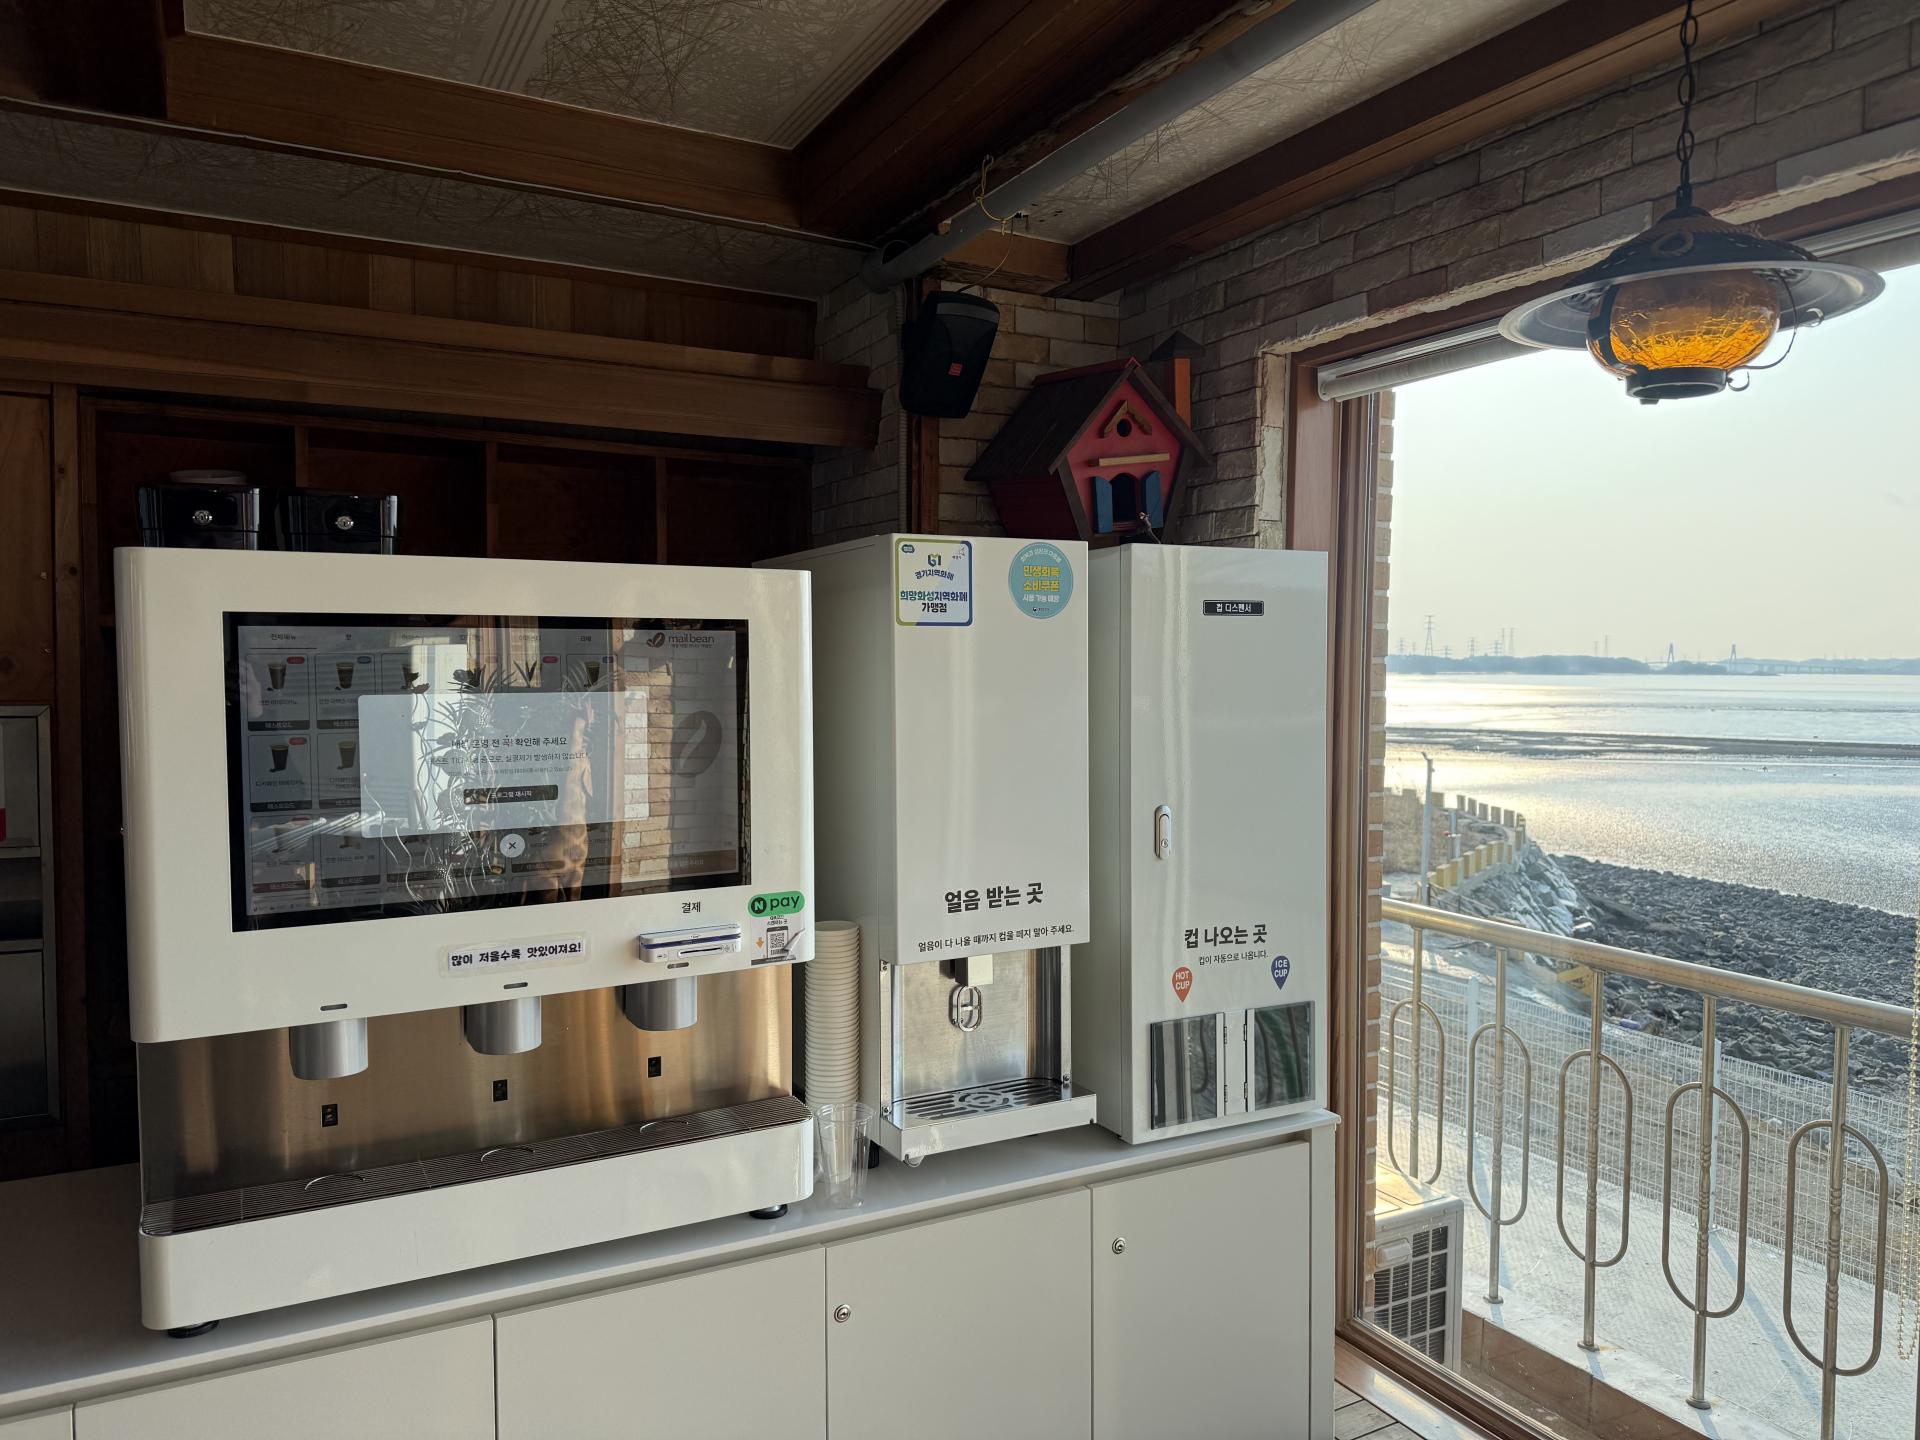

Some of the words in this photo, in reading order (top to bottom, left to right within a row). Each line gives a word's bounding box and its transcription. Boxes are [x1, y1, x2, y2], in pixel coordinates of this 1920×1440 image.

[1023, 565, 1061, 577] 민생회복
[1023, 580, 1060, 592] 소비쿠폰
[900, 590, 968, 602] 희망화성지역화폐
[921, 602, 947, 613] 가맹점
[1216, 603, 1223, 613] 컵
[1225, 603, 1252, 613] 디스펜서
[491, 738, 500, 748] 전
[515, 737, 541, 747] 확인해
[542, 736, 568, 746] 주세요
[770, 895, 800, 912] pay
[944, 889, 981, 914] 얼음
[986, 885, 1022, 909] 받는
[1026, 882, 1044, 905] 곳
[681, 901, 701, 913] 결제
[918, 938, 943, 953] 얼음이
[944, 938, 953, 949] 다
[955, 936, 972, 947] 나올
[973, 932, 997, 945] 때까지
[999, 930, 1014, 942] 컵을
[1033, 926, 1048, 938] 말아
[1184, 927, 1199, 949] 컵
[1204, 925, 1249, 947] 나오는
[1252, 924, 1268, 944] 곳
[451, 953, 473, 967] 많이
[478, 948, 521, 963] 저을수록
[527, 942, 582, 959] 맛있어져요!
[1199, 955, 1212, 966] 컵이
[1213, 952, 1240, 963] 자동으로
[1275, 959, 1288, 968] ICE
[1175, 971, 1190, 981] HOT
[1274, 968, 1288, 978] CUP
[1175, 981, 1190, 991] CUP
